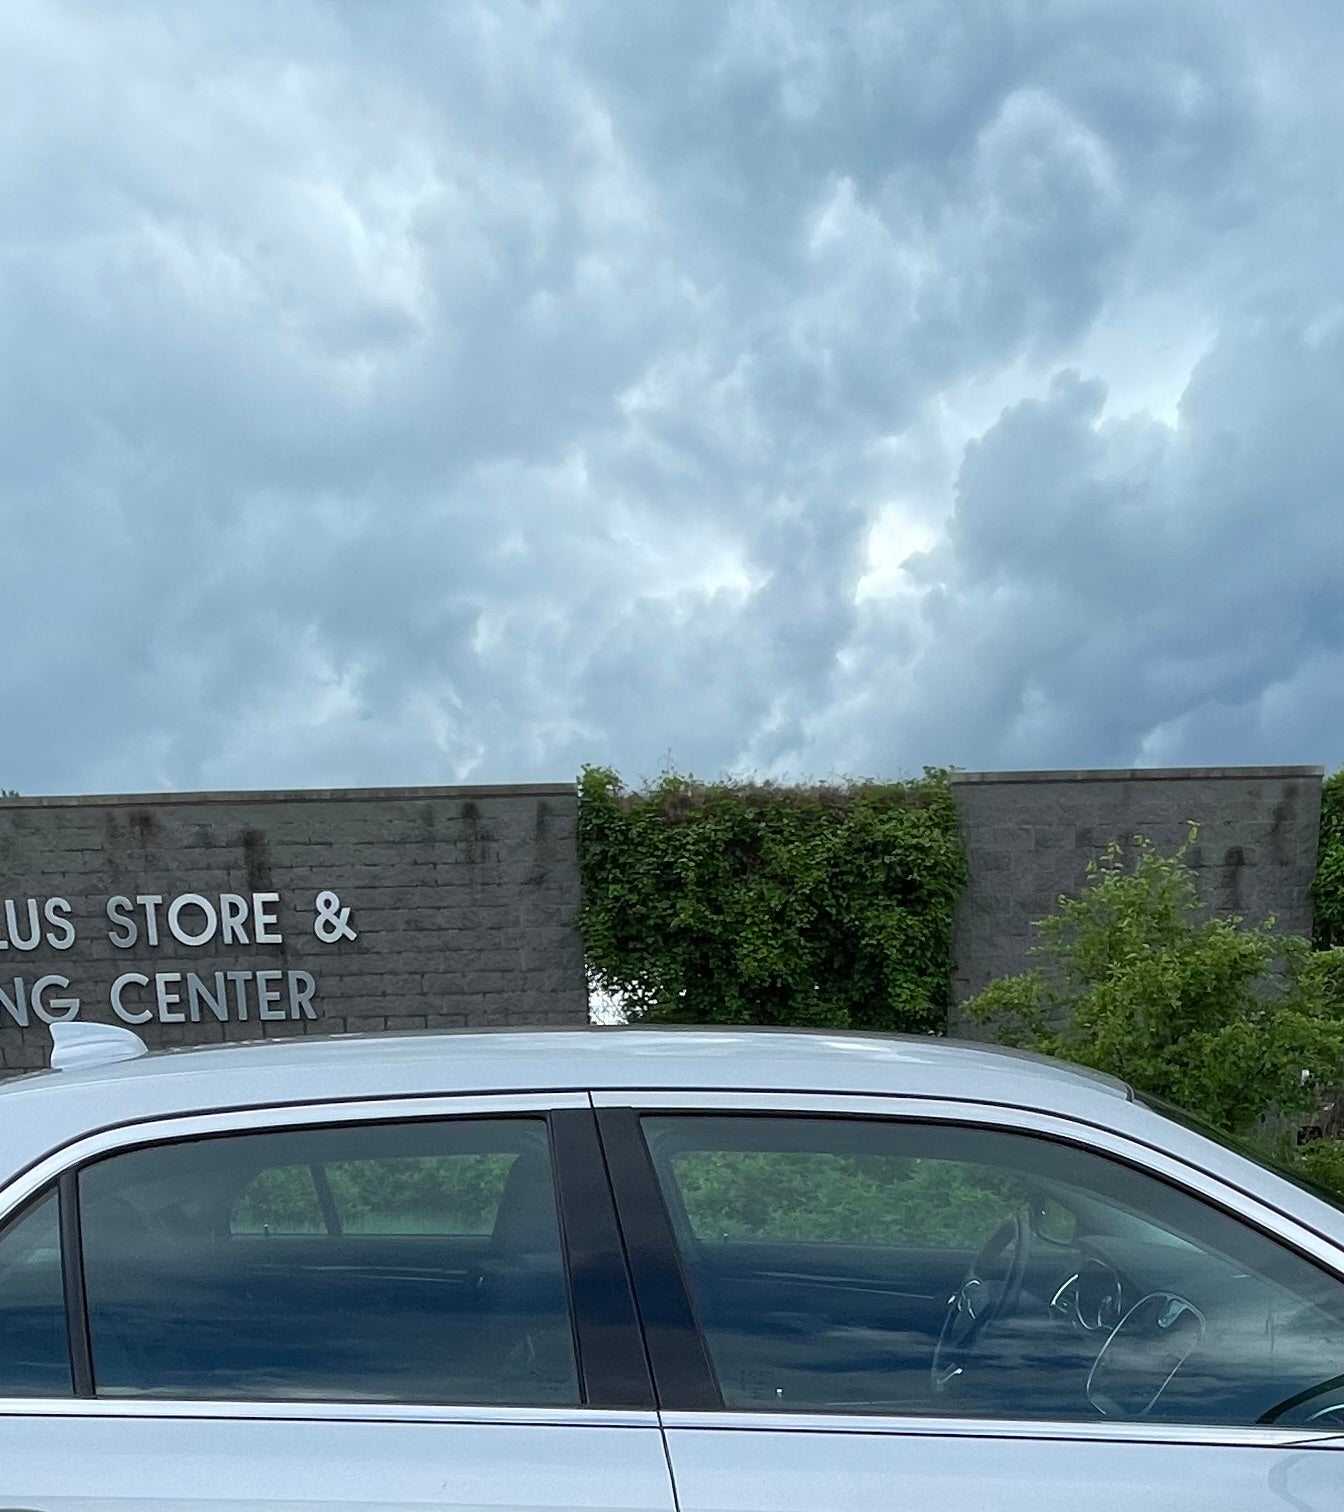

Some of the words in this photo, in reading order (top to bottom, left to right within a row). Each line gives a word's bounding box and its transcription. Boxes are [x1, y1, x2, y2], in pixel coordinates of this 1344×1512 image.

[107, 891, 283, 949] STORE
[313, 890, 358, 944] &
[110, 970, 318, 1025] CENTER
